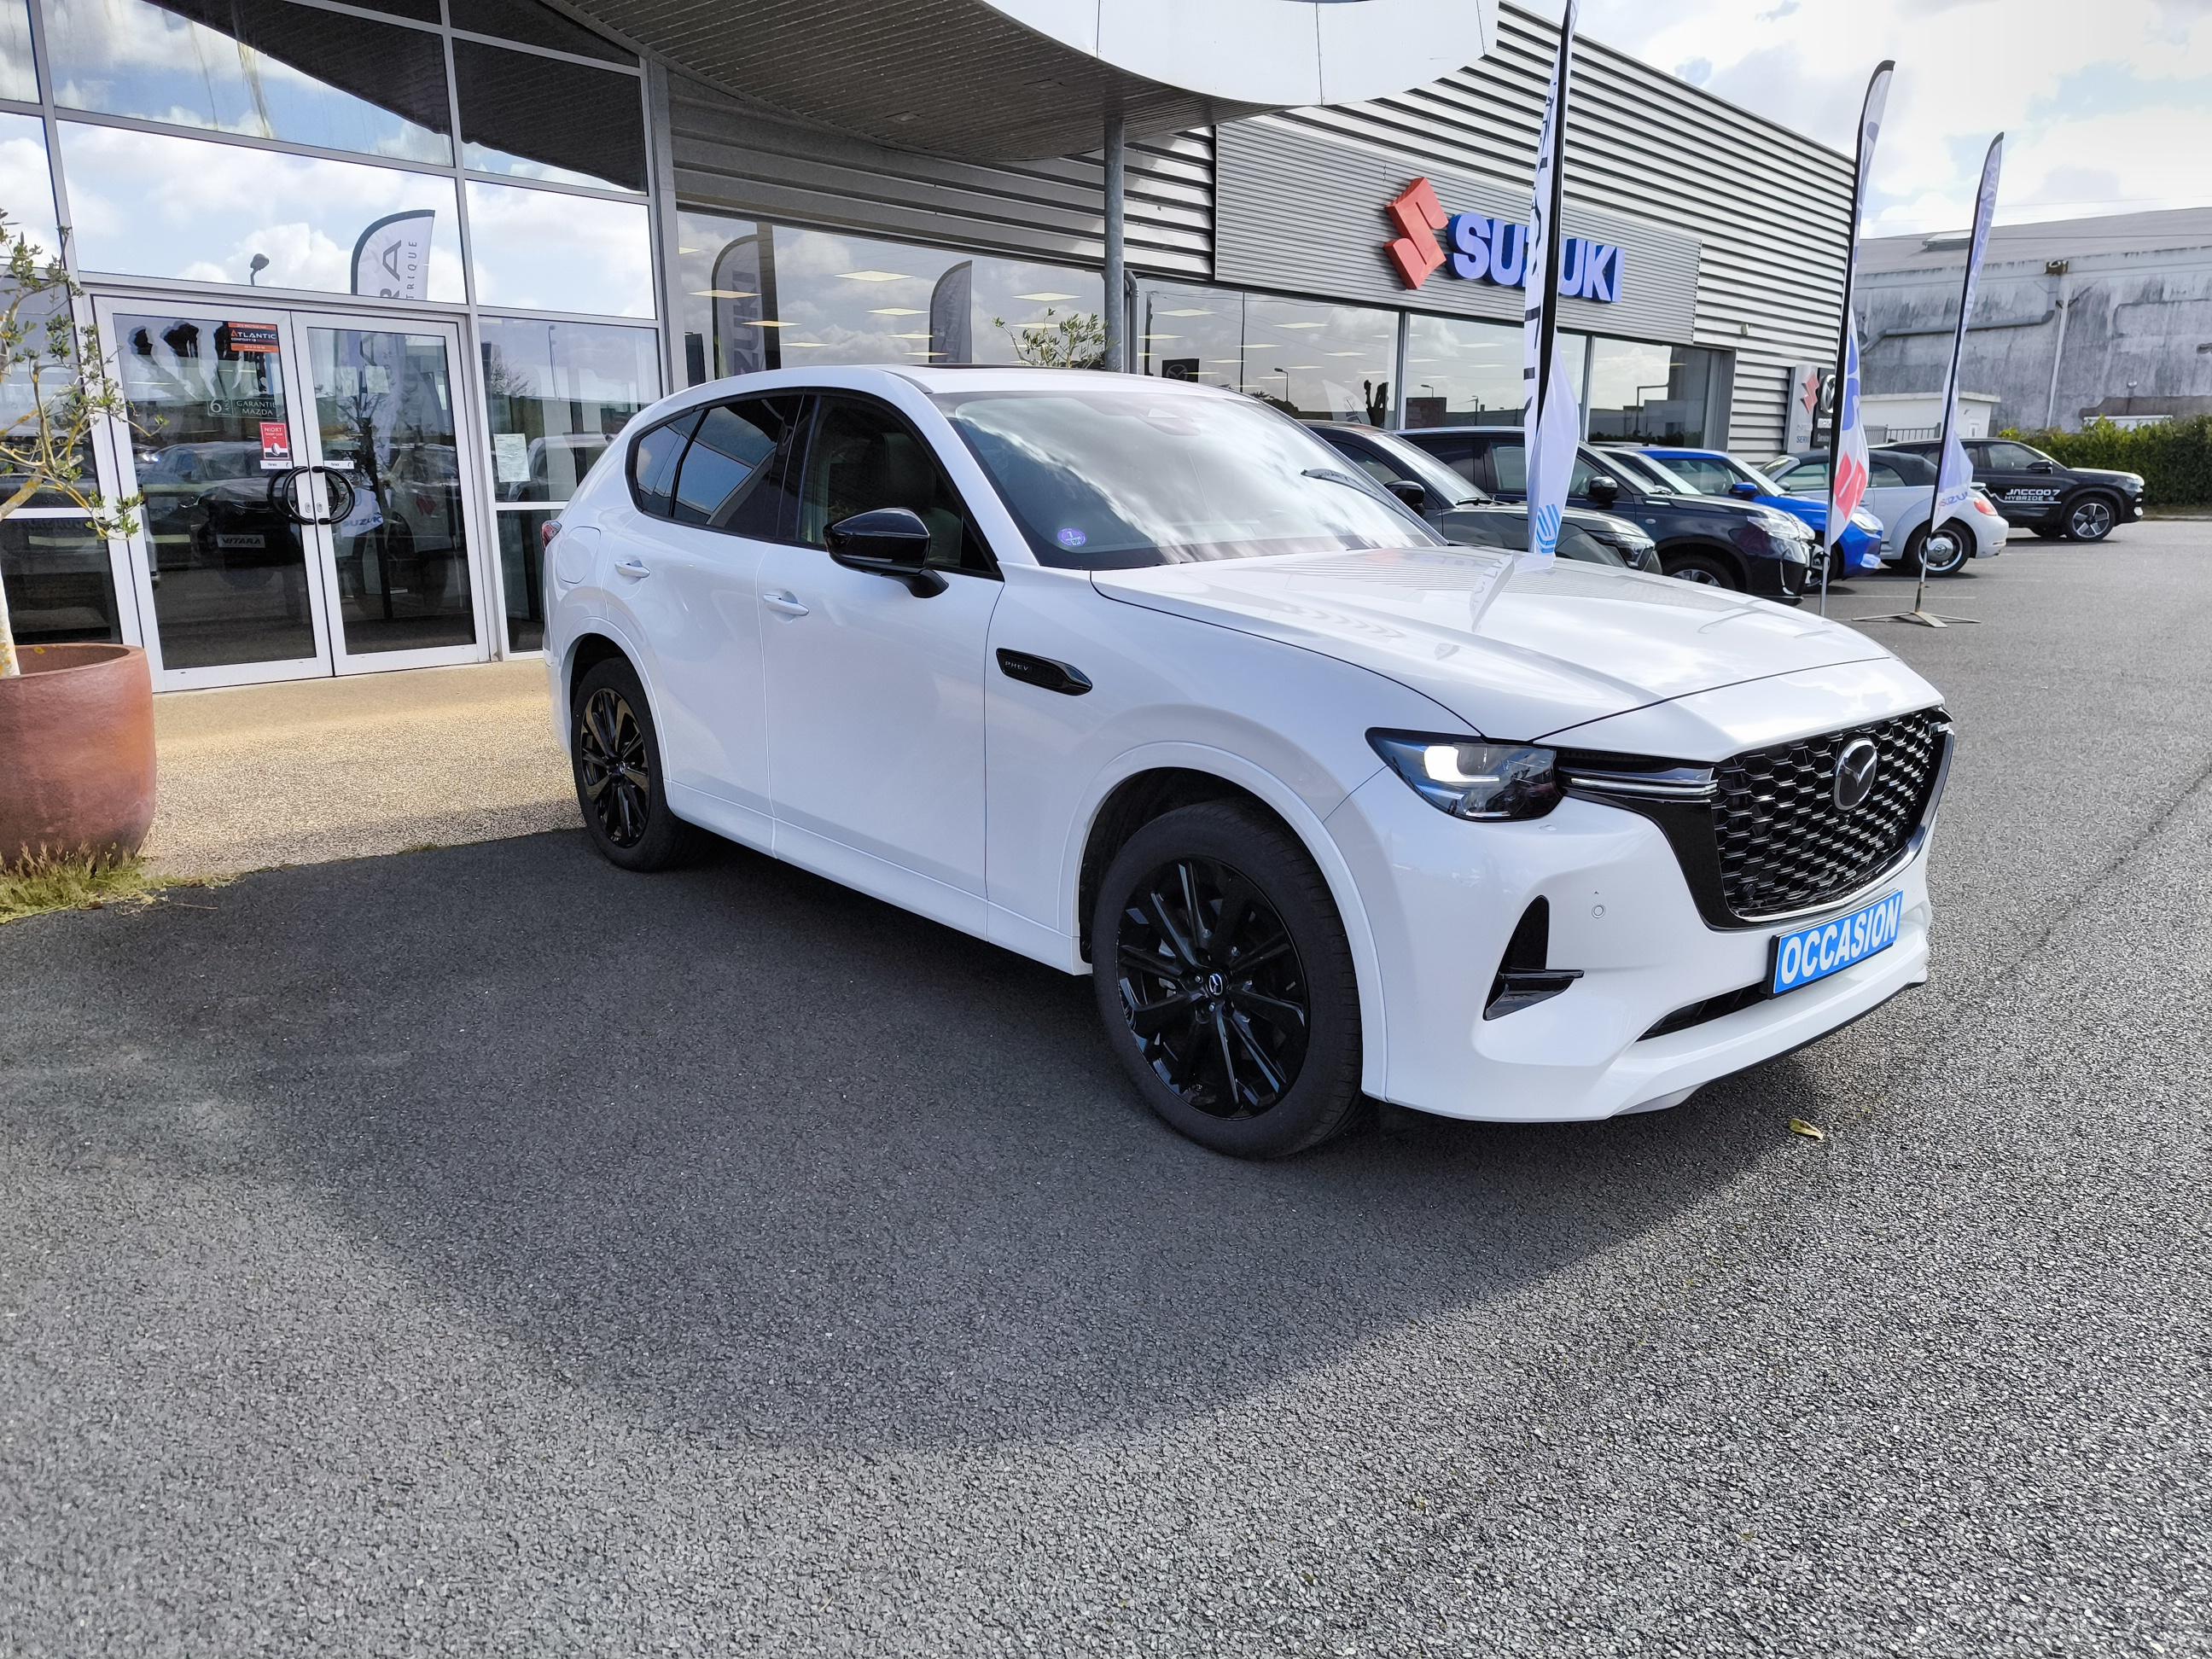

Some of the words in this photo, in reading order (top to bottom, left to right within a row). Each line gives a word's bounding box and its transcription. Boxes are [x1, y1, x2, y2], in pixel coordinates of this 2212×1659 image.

[1450, 212, 1625, 303] SUUKI
[230, 329, 276, 340] ATLANTIC
[210, 398, 222, 413] 6
[222, 536, 261, 544] VITARA
[1004, 661, 1029, 672] PHEV
[1781, 896, 1900, 985] OCCASION
